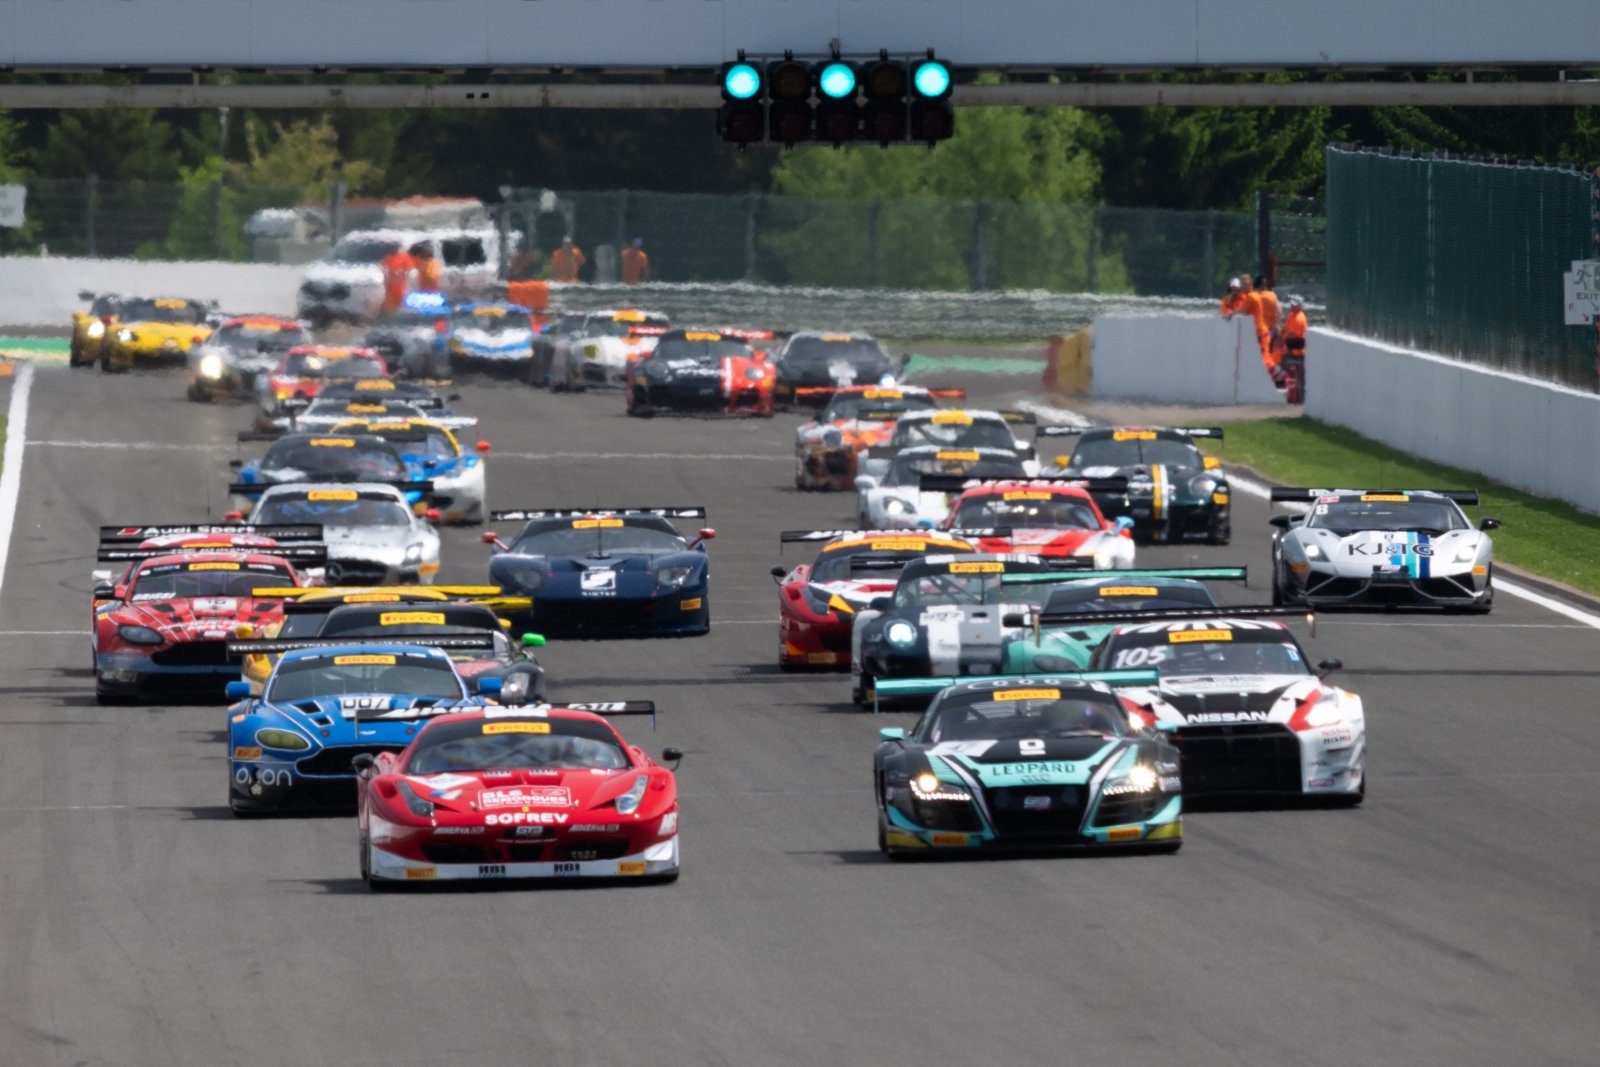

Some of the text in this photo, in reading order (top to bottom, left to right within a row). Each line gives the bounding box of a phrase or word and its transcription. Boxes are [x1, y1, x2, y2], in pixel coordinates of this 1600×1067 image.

[144, 526, 192, 536] Audi
[197, 525, 255, 537] Sport
[1114, 647, 1168, 668] 105
[1187, 711, 1268, 723] NISSAN
[992, 762, 1076, 777] LEOPARD
[485, 813, 569, 825] SOFREV
